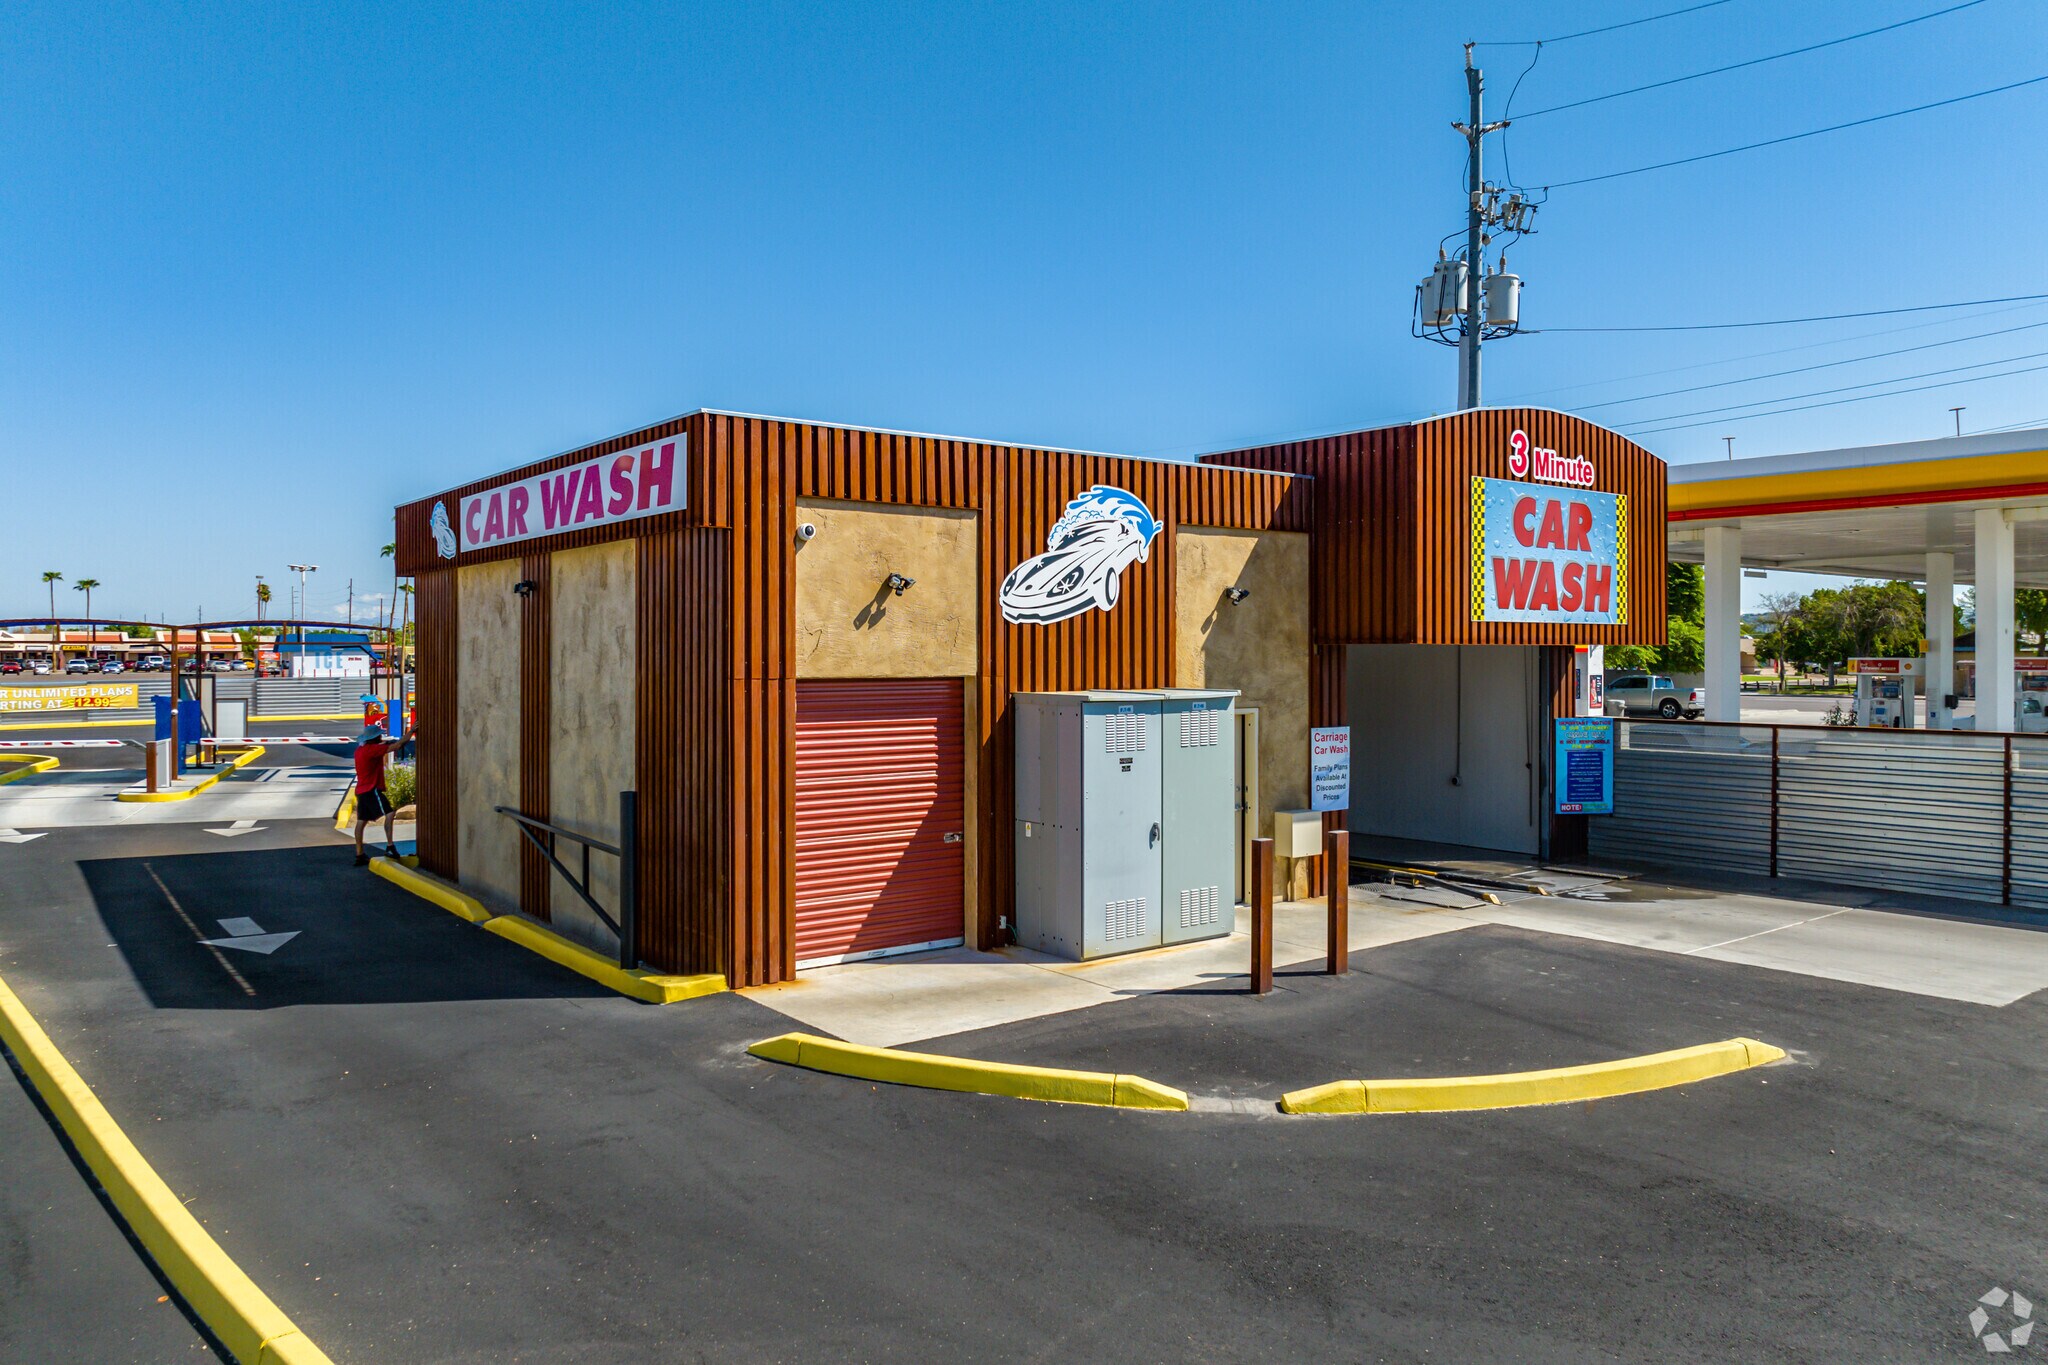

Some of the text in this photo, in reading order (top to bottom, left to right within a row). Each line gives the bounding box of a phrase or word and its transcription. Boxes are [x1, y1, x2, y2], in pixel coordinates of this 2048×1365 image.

[1510, 431, 1594, 485] 3 Minute
[465, 442, 675, 546] CAR WASH
[1512, 495, 1593, 552] CAR
[1491, 556, 1612, 613] WASH
[315, 651, 343, 669] ICE
[12, 688, 87, 699] UNLIMITED
[91, 687, 133, 696] PLANS
[46, 700, 63, 709] AT
[1314, 732, 1348, 743] Carriage
[1314, 745, 1348, 755] Car Wash
[1314, 765, 1332, 773] Family
[1315, 774, 1340, 782] Available
[1316, 783, 1346, 792] Discounted
